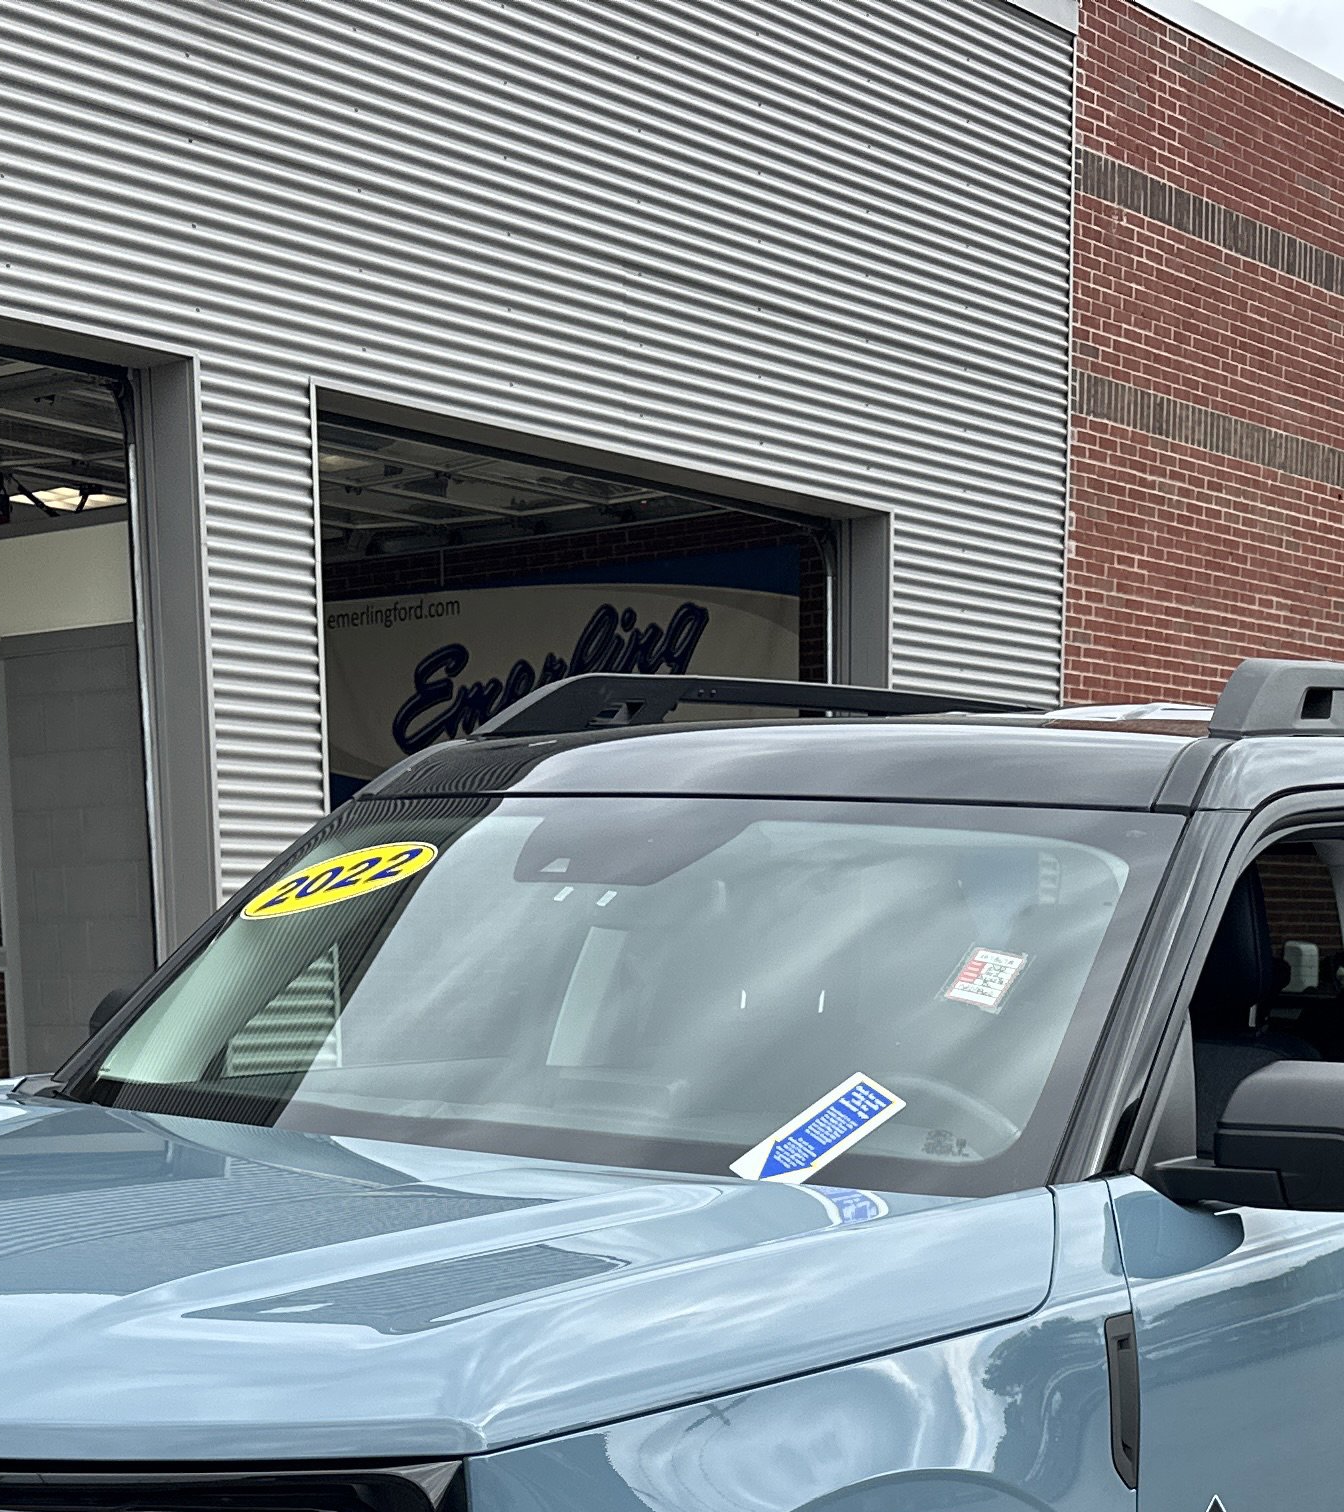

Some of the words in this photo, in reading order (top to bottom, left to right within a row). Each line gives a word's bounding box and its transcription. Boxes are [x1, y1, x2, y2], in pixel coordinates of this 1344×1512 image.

[327, 600, 461, 629] emerlingford.com
[392, 602, 709, 755] Emerling
[253, 848, 424, 913] 2022
